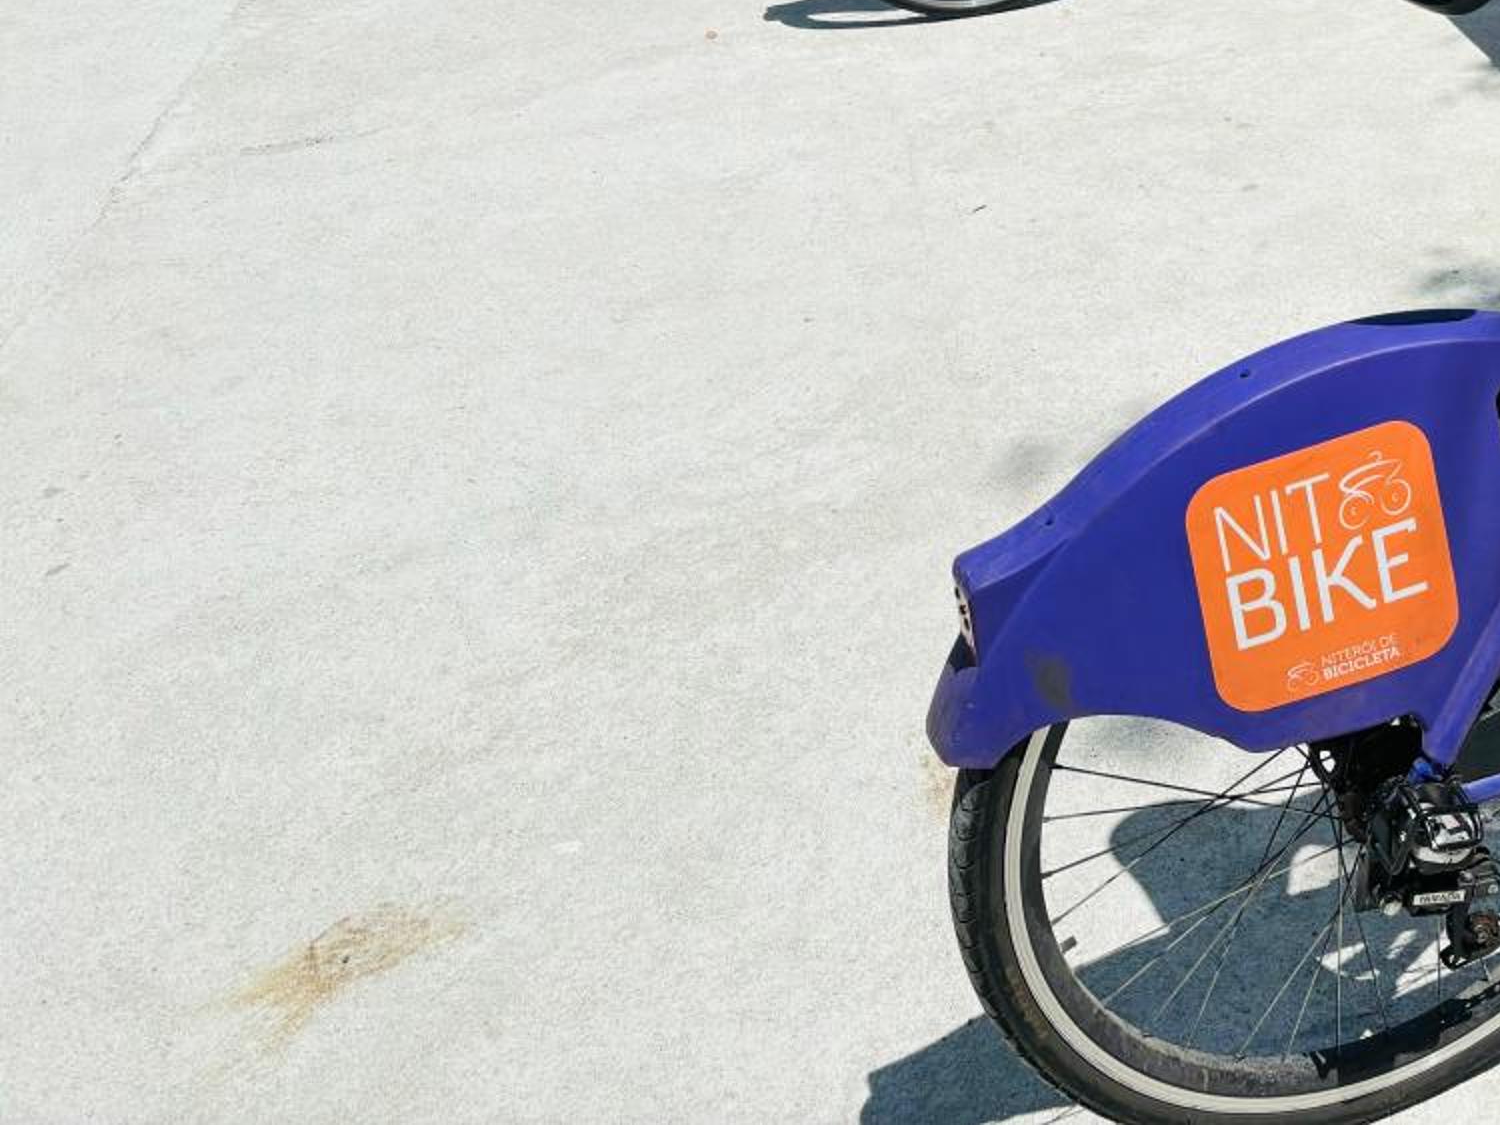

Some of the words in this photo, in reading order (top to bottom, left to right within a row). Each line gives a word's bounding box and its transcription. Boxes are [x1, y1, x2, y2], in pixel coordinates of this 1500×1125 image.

[1213, 473, 1331, 573] NIT
[1226, 517, 1429, 652] BIKE
[1322, 646, 1401, 681] BICICLETA
